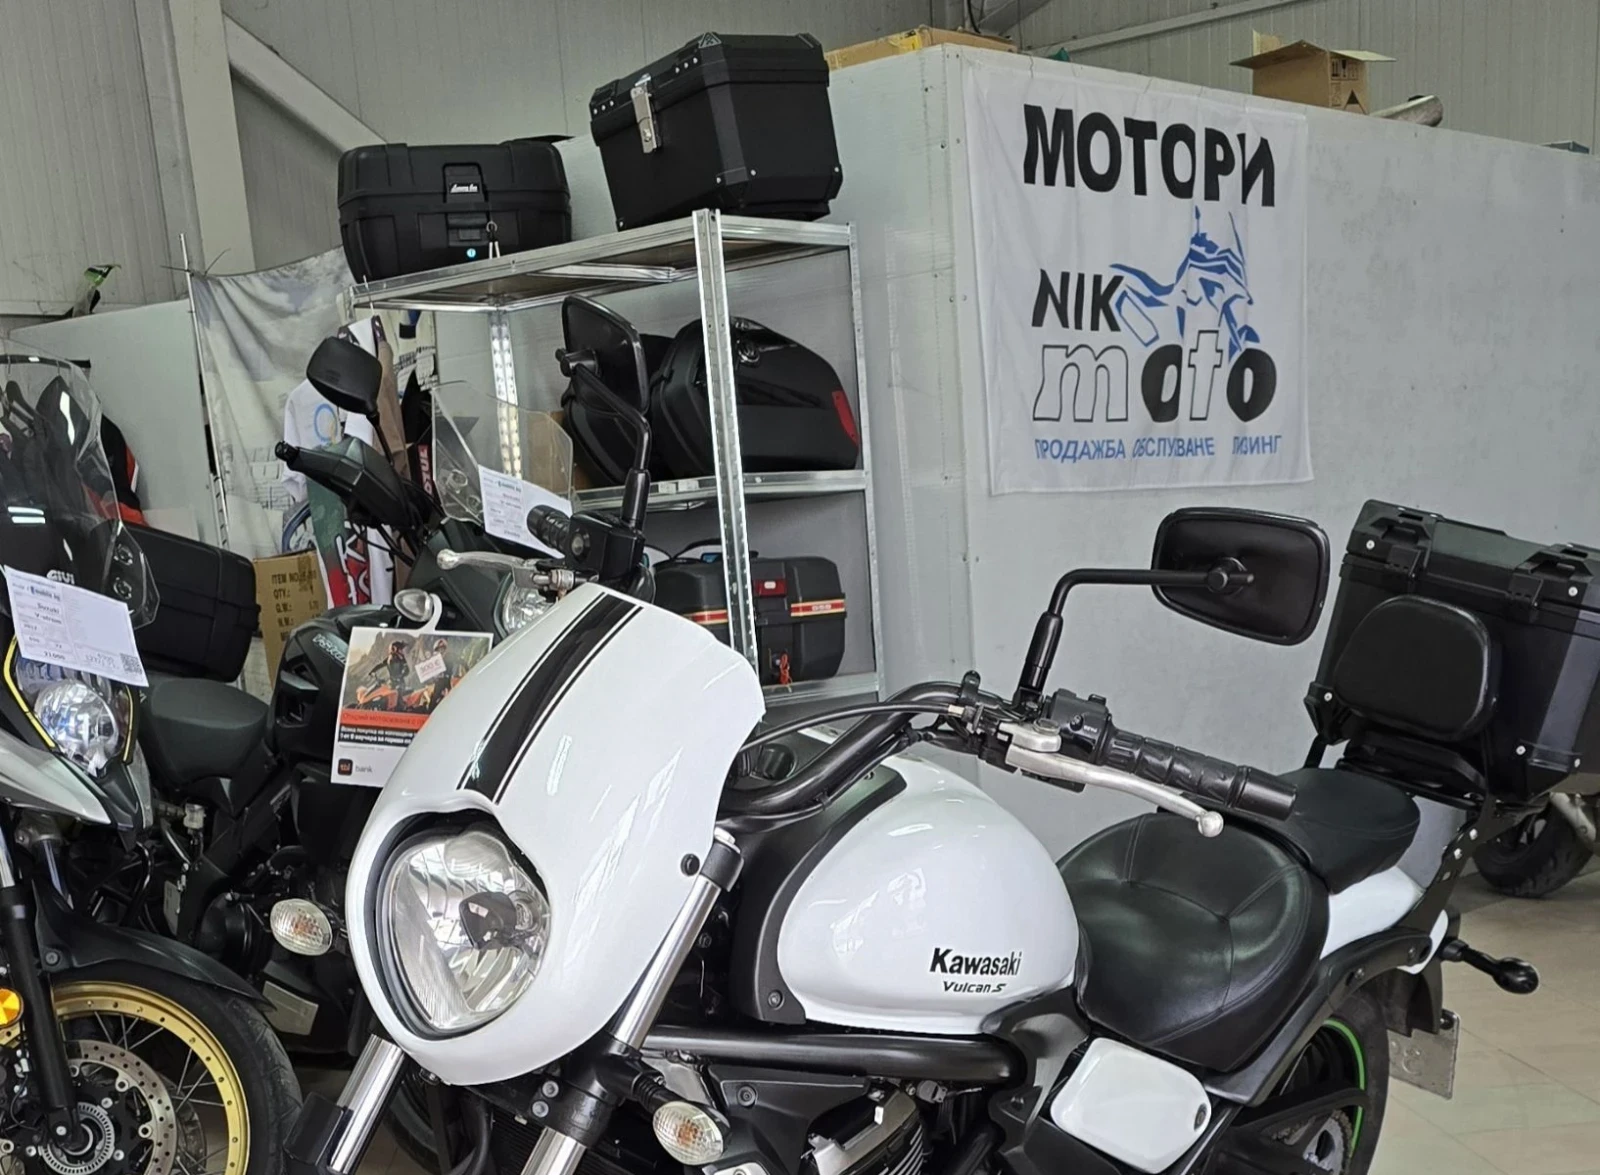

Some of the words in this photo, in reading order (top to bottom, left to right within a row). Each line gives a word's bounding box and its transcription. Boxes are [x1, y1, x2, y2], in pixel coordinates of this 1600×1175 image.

[1024, 104, 1275, 207] МОТОРИ
[1032, 269, 1124, 332] NIK
[1033, 330, 1277, 423] moto
[1034, 438, 1126, 463] ПРОДАЖБА
[46, 569, 75, 584] GIVI
[929, 947, 1022, 976] Kawasaki
[943, 980, 991, 993] Vulcan
[991, 983, 1007, 993] S
